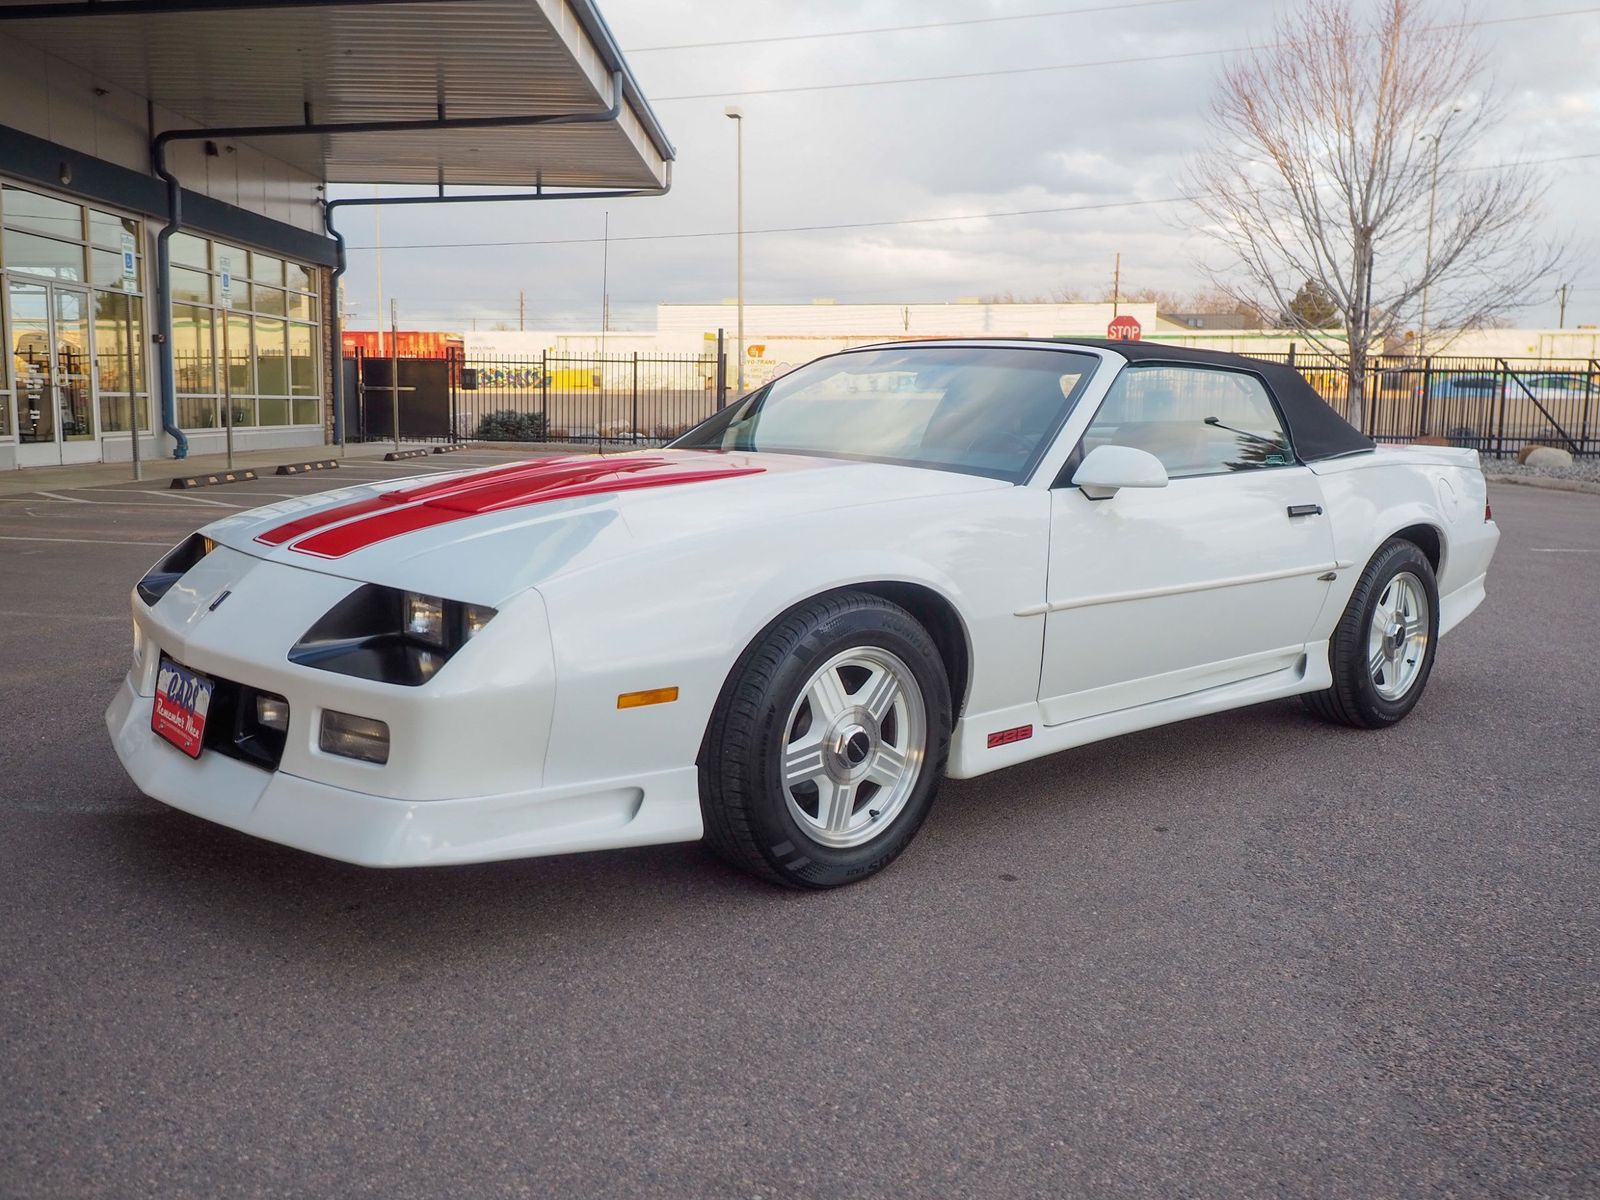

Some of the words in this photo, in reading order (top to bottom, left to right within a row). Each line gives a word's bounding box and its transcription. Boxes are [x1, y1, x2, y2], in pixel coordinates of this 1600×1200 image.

[1109, 325, 1140, 339] STOP
[167, 673, 199, 717] CARS
[157, 698, 185, 729] Remember
[988, 725, 1033, 748] Z28
